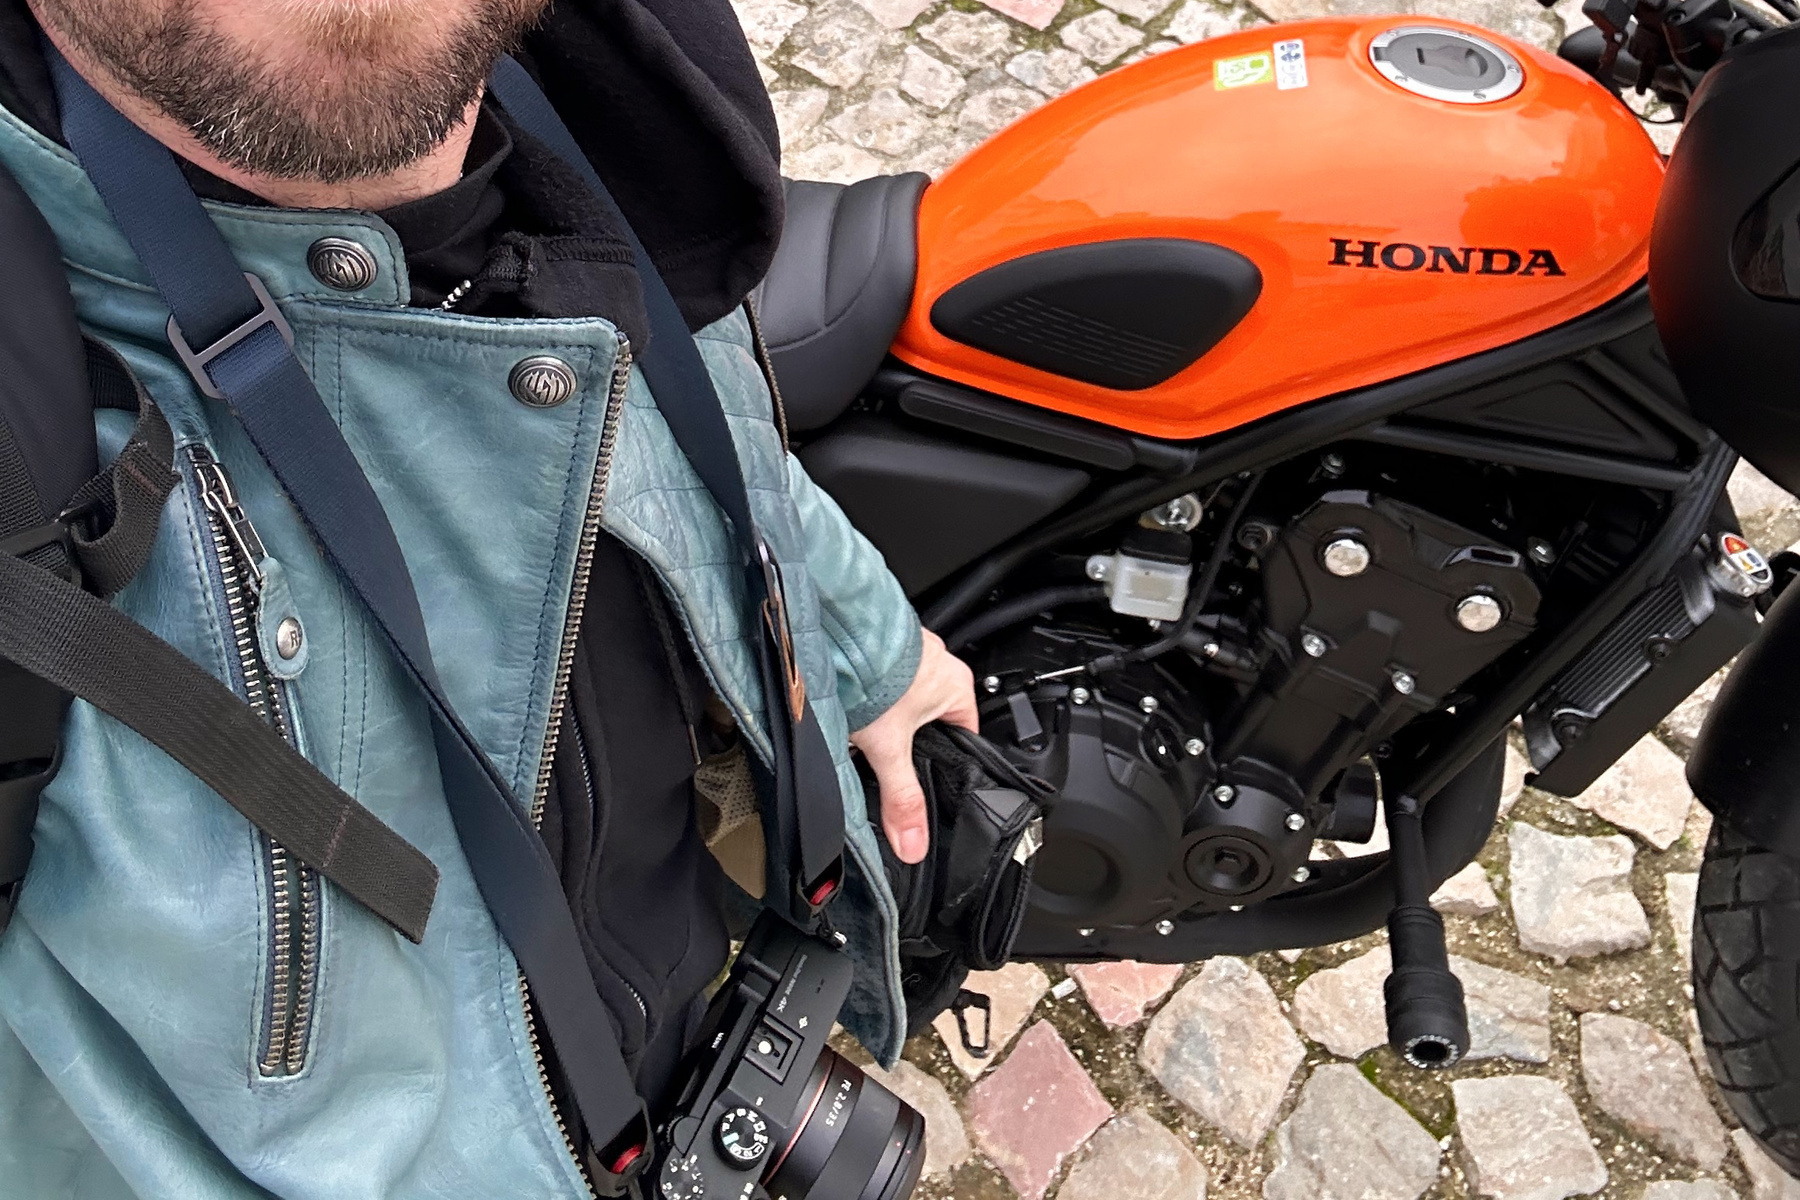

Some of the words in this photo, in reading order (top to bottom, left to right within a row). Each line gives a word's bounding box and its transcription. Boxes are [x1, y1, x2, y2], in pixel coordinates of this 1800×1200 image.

[1328, 237, 1567, 277] HONDA
[776, 996, 788, 1013] 4K
[841, 1079, 852, 1092] FE
[825, 1092, 847, 1127] 2.8/35
